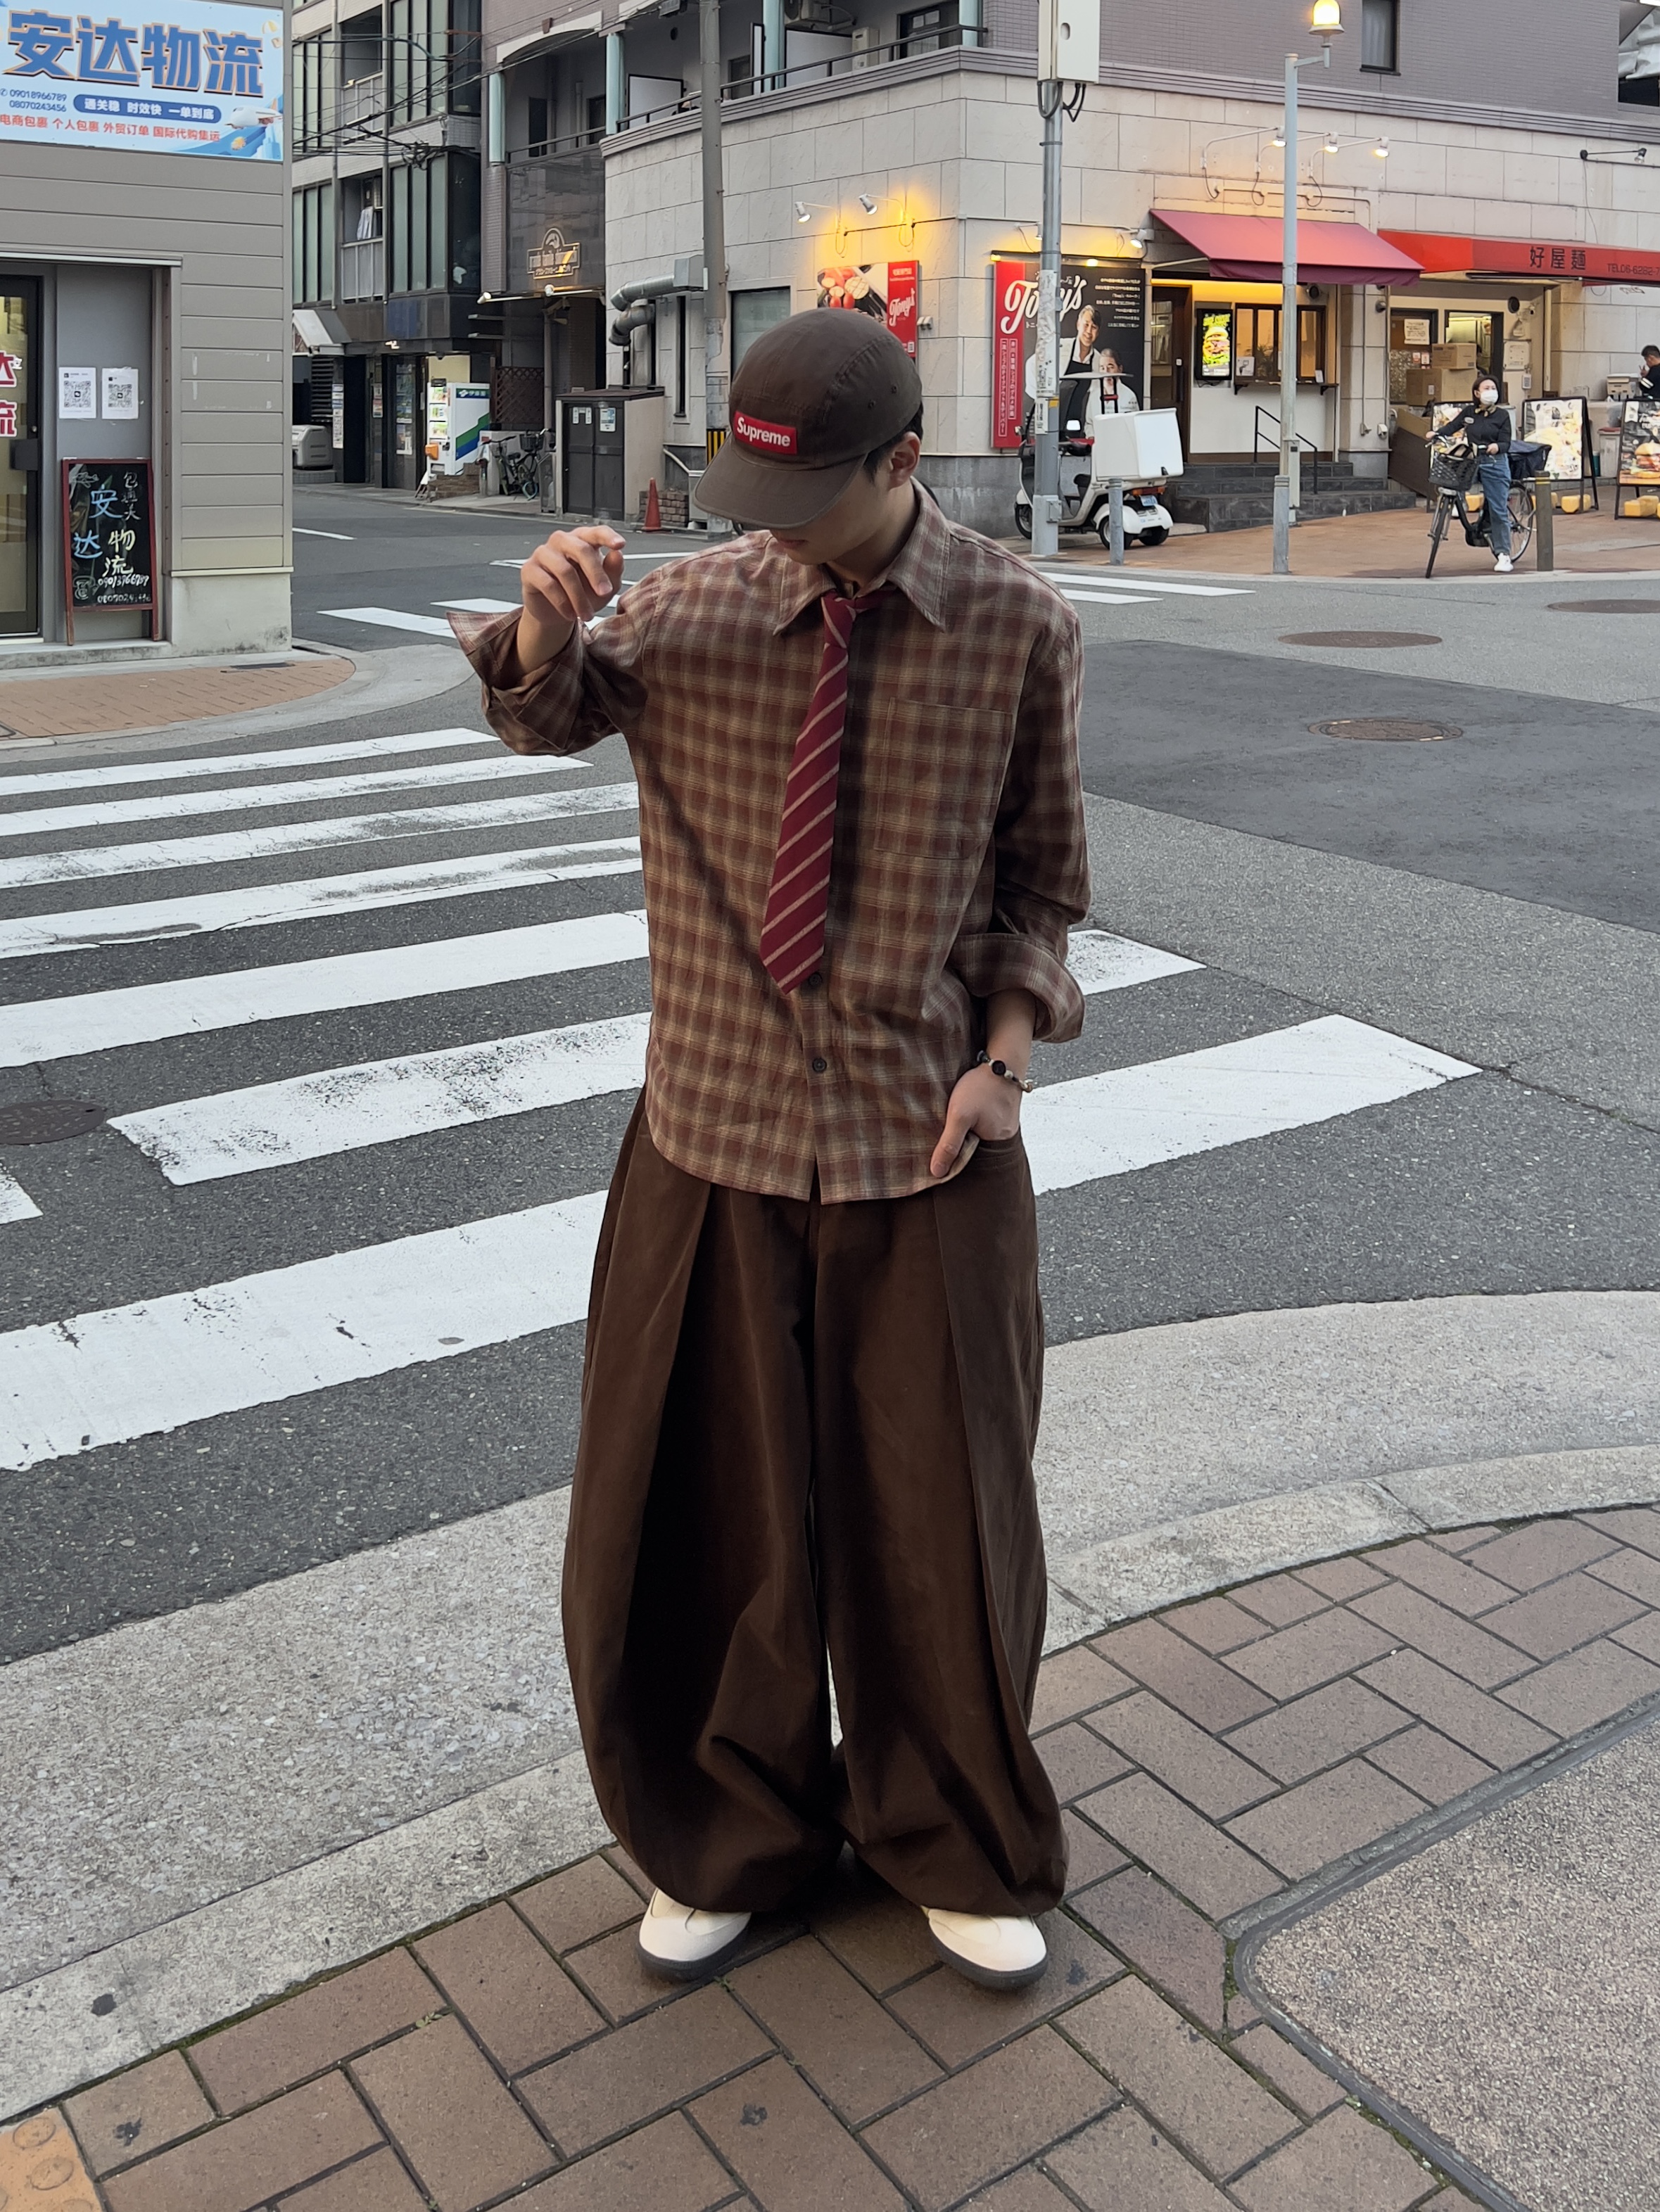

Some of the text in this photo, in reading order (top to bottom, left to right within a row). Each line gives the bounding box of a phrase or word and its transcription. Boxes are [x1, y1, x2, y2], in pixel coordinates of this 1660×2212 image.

[3, 9, 263, 97] 安达物流
[84, 98, 215, 120] 通关稳 时效快 一单到底
[0, 114, 220, 141] 电商包裹 个人包裹 外贸订单 国际代购集运
[1000, 275, 1087, 334] Toy's
[737, 417, 790, 447] Supreme
